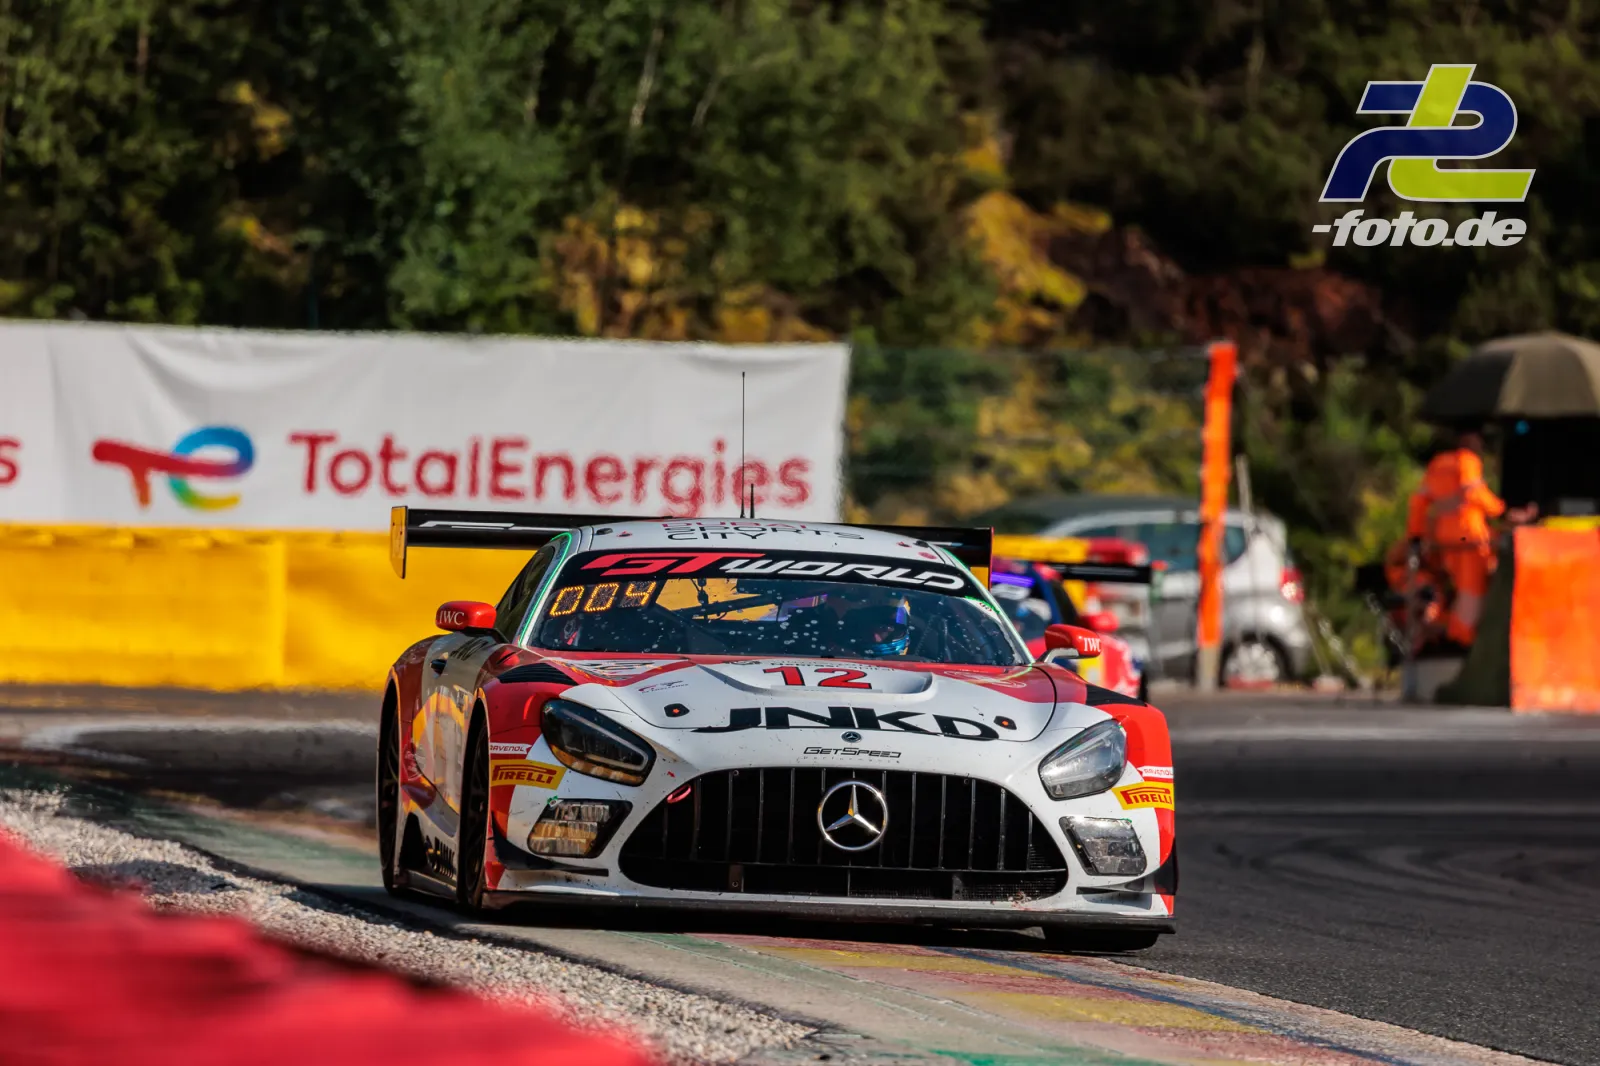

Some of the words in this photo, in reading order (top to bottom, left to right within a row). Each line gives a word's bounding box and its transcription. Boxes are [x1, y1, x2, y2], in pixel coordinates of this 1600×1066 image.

[288, 432, 812, 518] TotalEnergies
[665, 526, 865, 539] SPORTS
[668, 532, 768, 541] CITY
[549, 580, 657, 617] 004
[439, 610, 465, 625] IWC
[762, 665, 873, 690] 12
[690, 706, 999, 741] JNKD
[492, 764, 557, 784] PIRELLI
[1120, 786, 1173, 805] PIRELLI
